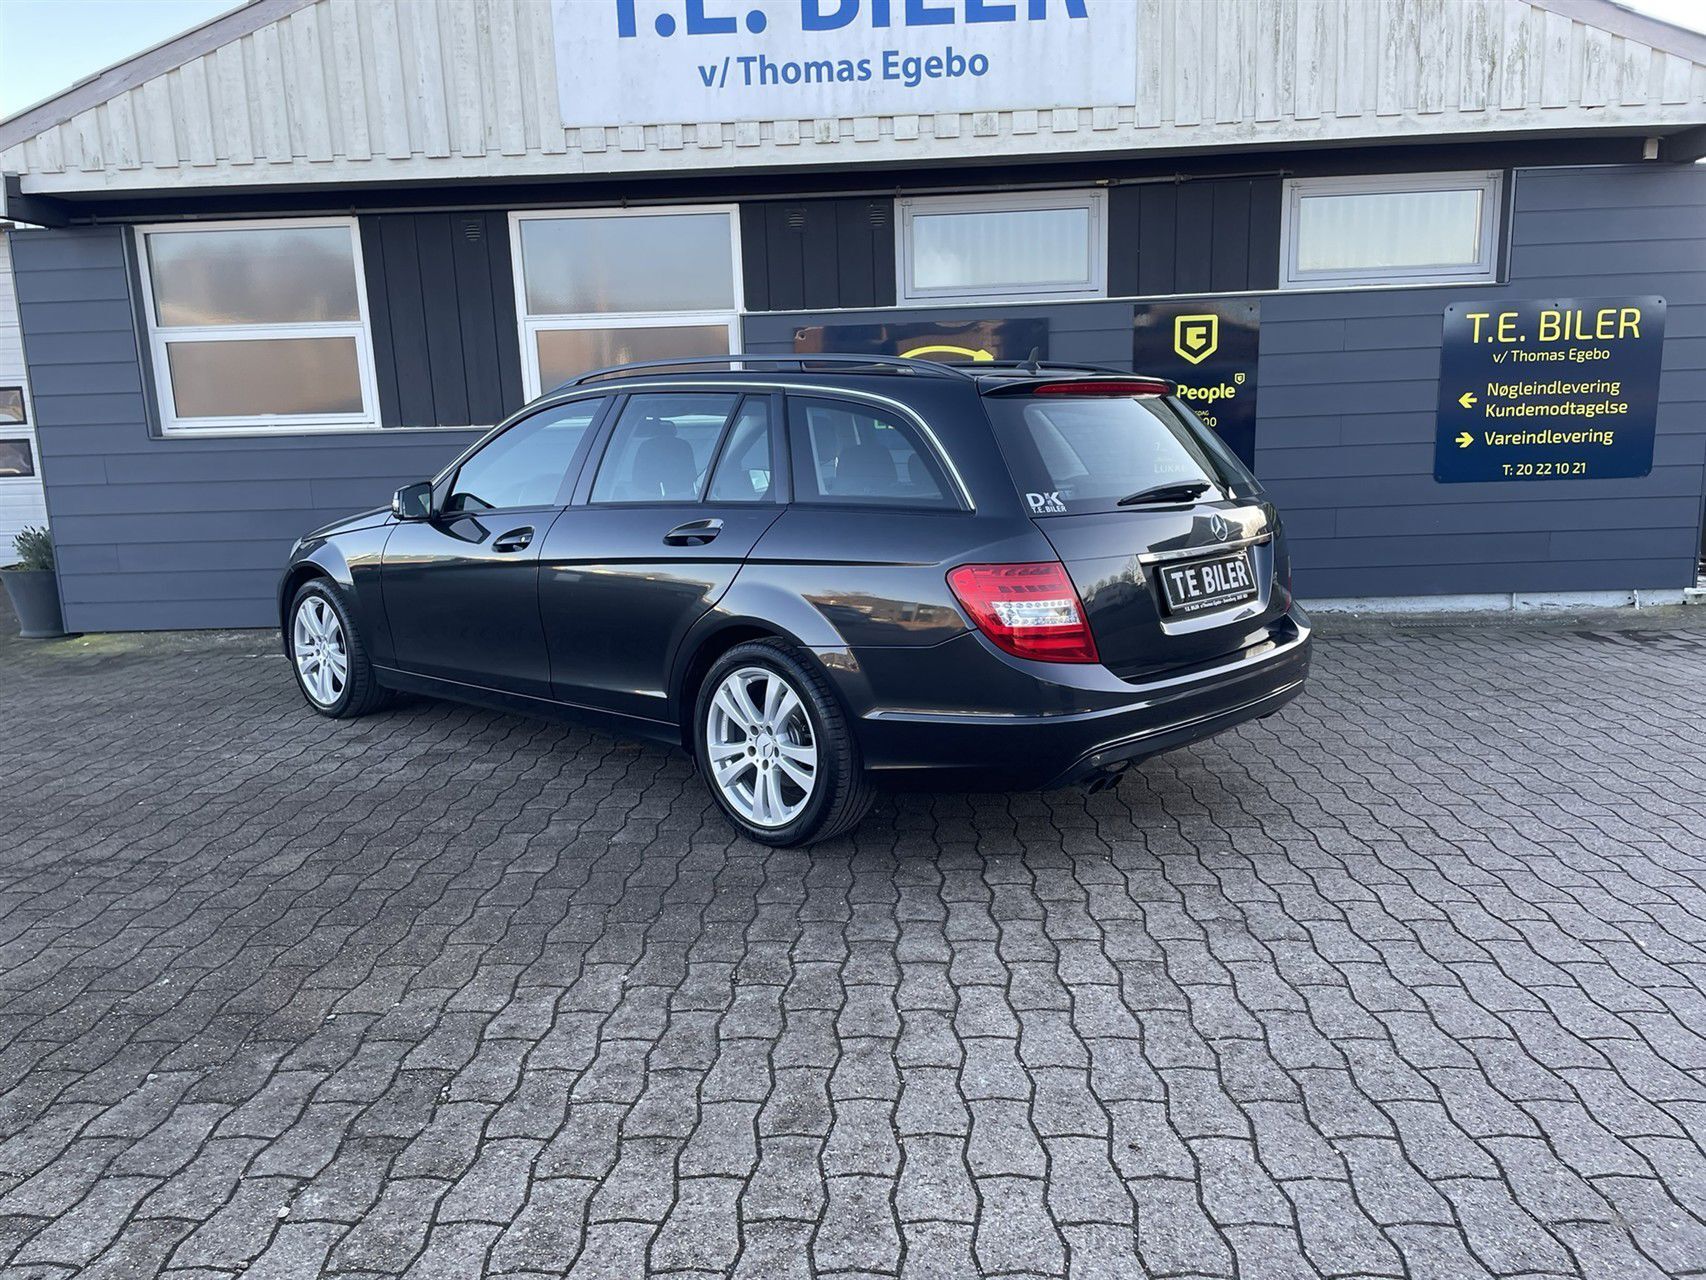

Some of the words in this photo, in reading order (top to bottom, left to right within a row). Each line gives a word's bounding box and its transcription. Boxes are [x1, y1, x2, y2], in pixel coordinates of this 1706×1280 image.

[698, 56, 731, 88] v/
[736, 54, 873, 86] Thomas
[882, 46, 989, 88] Egebo
[1466, 312, 1526, 344] T.E.
[1538, 307, 1641, 342] BILER
[1492, 350, 1509, 364] v/
[1510, 349, 1565, 362] Thomas
[1568, 347, 1610, 363] Egebo
[1487, 379, 1621, 399] Nøgleindlevering
[1485, 400, 1628, 418] Kundemodtagelse
[1203, 416, 1217, 427] 00
[1484, 428, 1614, 446] Vareindlevering
[1502, 464, 1513, 476] T:
[1516, 463, 1533, 476] 20
[1536, 463, 1552, 475] 22
[1555, 462, 1570, 475] 10
[1572, 462, 1587, 474] 21
[1171, 569, 1202, 599] T.E.
[1202, 560, 1250, 594] BILER
